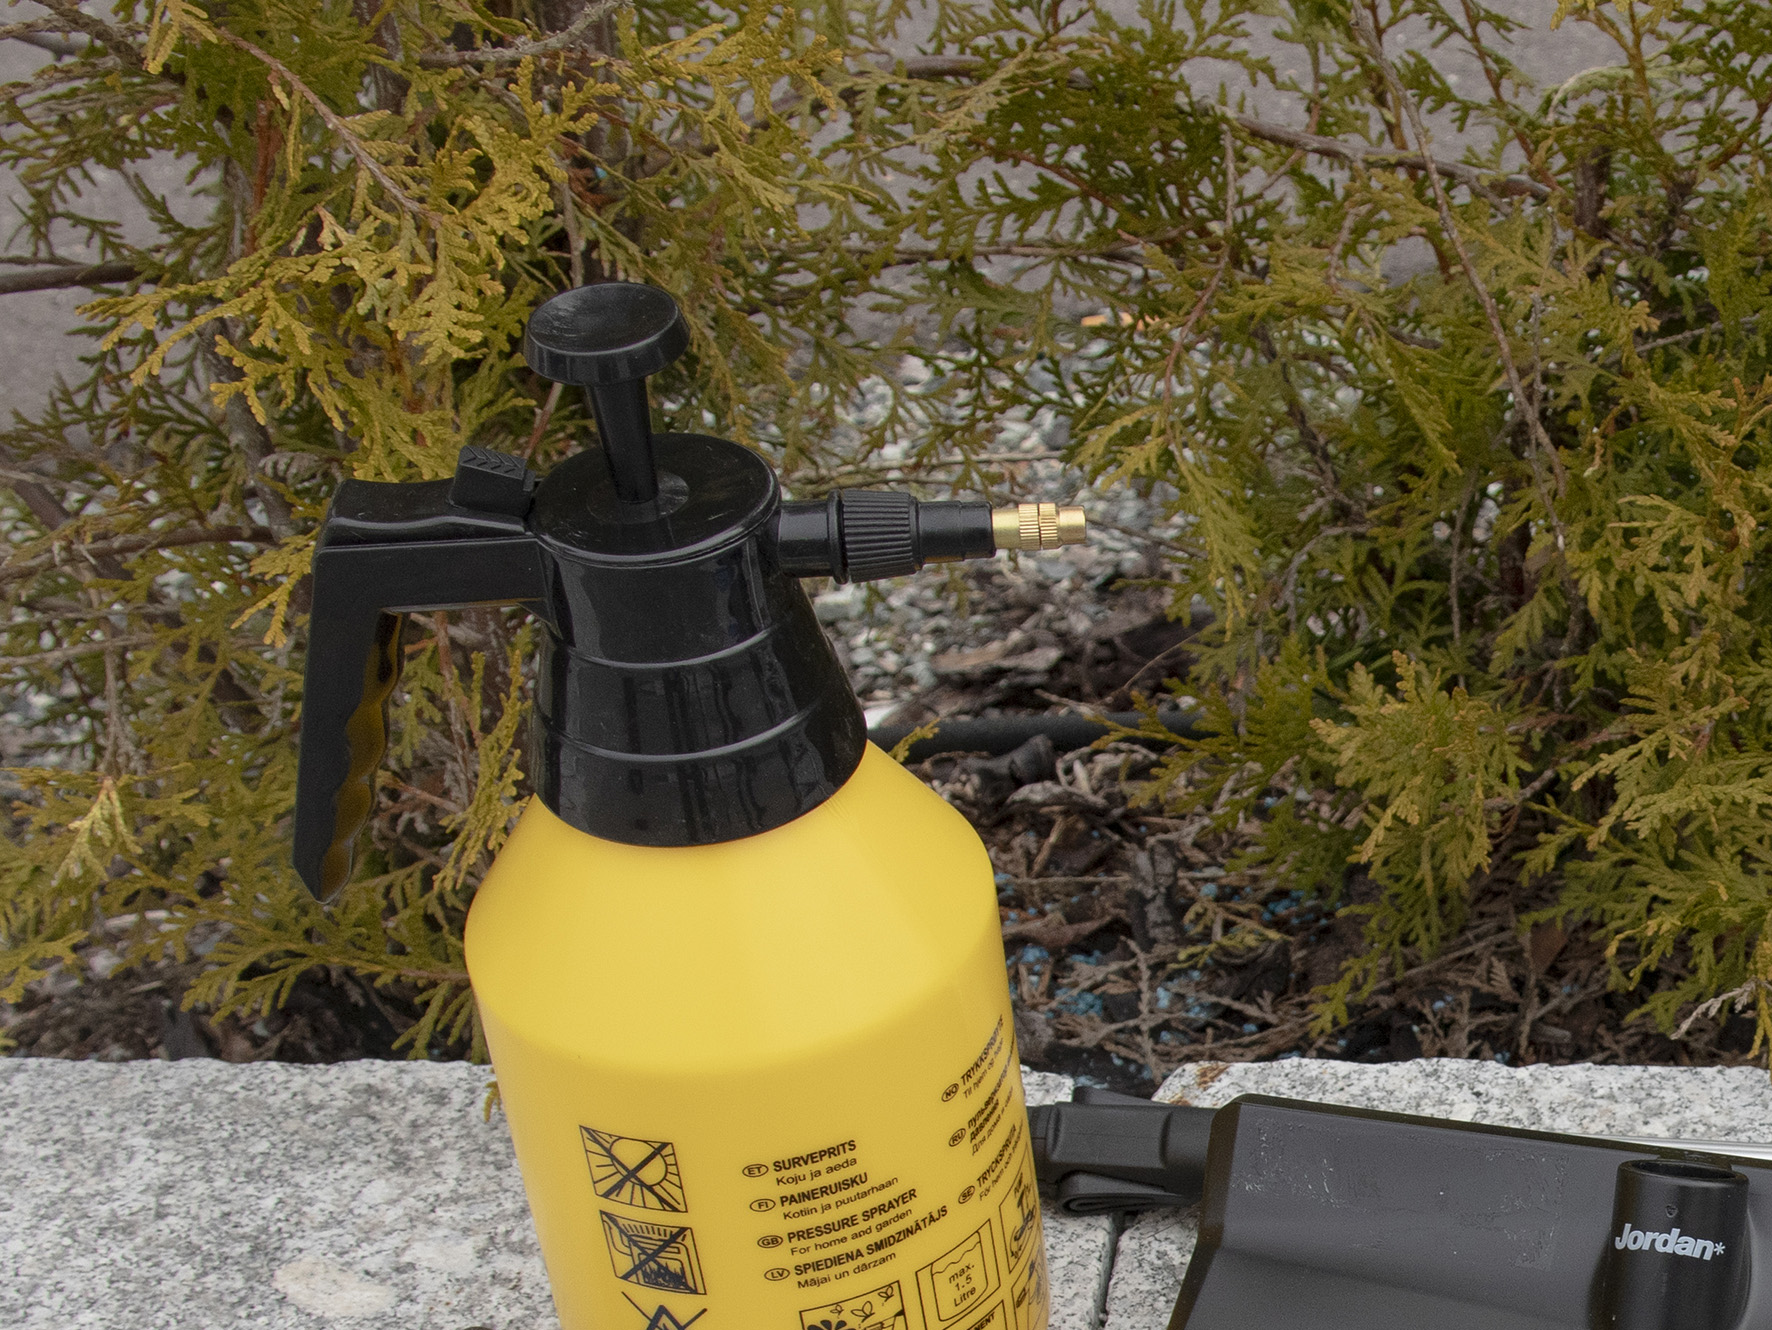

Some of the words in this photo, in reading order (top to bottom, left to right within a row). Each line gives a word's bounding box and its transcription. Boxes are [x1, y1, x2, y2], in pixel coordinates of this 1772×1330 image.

[952, 1131, 964, 1144] RU
[747, 1166, 762, 1175] ET
[773, 1140, 857, 1172] SURVEPRITS
[776, 1173, 806, 1186] Koju
[809, 1169, 822, 1181] ja
[825, 1158, 857, 1174] aeda
[758, 1201, 769, 1209] FI
[780, 1172, 868, 1207] PAINERUISKU
[783, 1207, 818, 1220] Kotiin
[821, 1203, 832, 1214] ja
[835, 1177, 899, 1209] puutarhaan
[961, 1188, 972, 1201] SE
[761, 1237, 779, 1246] GB
[787, 1214, 859, 1243] PRESSURE
[861, 1188, 917, 1222] SPRAYER
[790, 1246, 811, 1256] For
[815, 1235, 848, 1250] home
[851, 1227, 873, 1240] and
[877, 1209, 912, 1232] garden
[771, 1270, 785, 1279] LV
[794, 1249, 864, 1276] SPIEDIENA
[866, 1205, 948, 1255] SMIDZINĀTĀJS
[1615, 1223, 1715, 1260] Jordan
[797, 1275, 831, 1289] Mājai
[835, 1271, 850, 1280] un
[853, 1251, 896, 1274] dārzam
[949, 1263, 975, 1284] max.
[955, 1274, 972, 1291] 1.5
[953, 1286, 976, 1307] Litre
